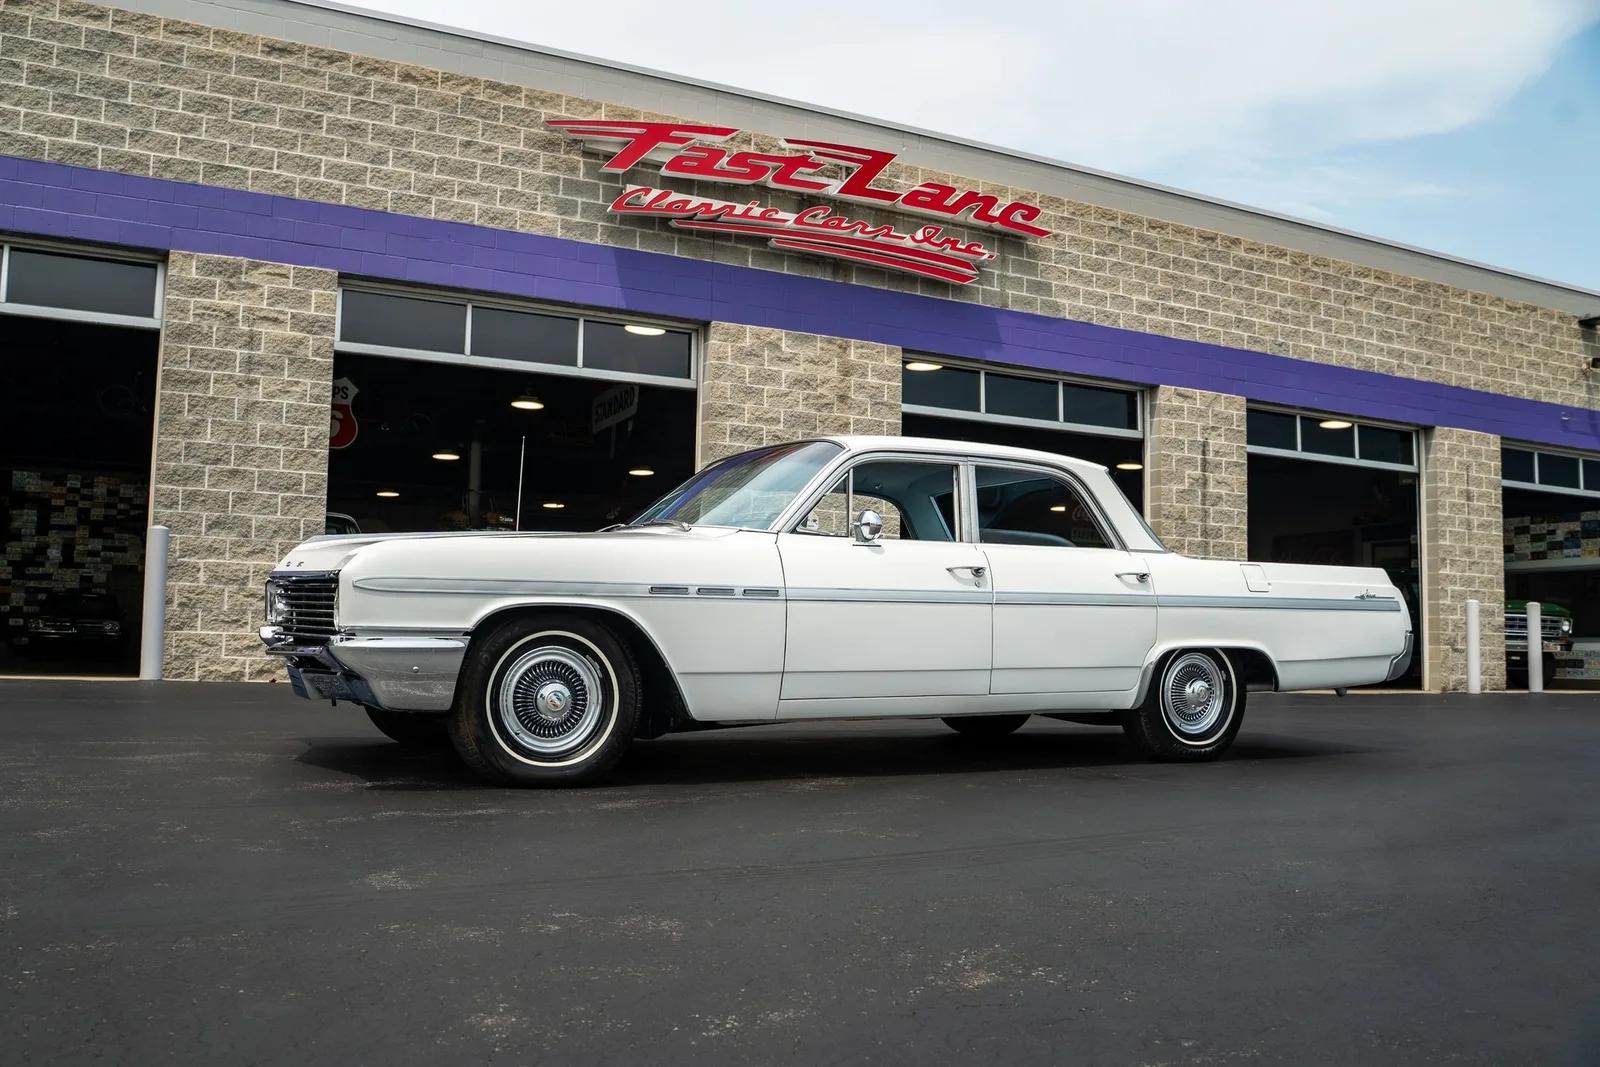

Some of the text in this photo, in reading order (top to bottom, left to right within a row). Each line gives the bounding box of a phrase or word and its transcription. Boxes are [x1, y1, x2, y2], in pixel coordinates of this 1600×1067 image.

[545, 119, 1053, 238] Fast Lane
[608, 186, 792, 223] Classic
[793, 206, 910, 240] Cars
